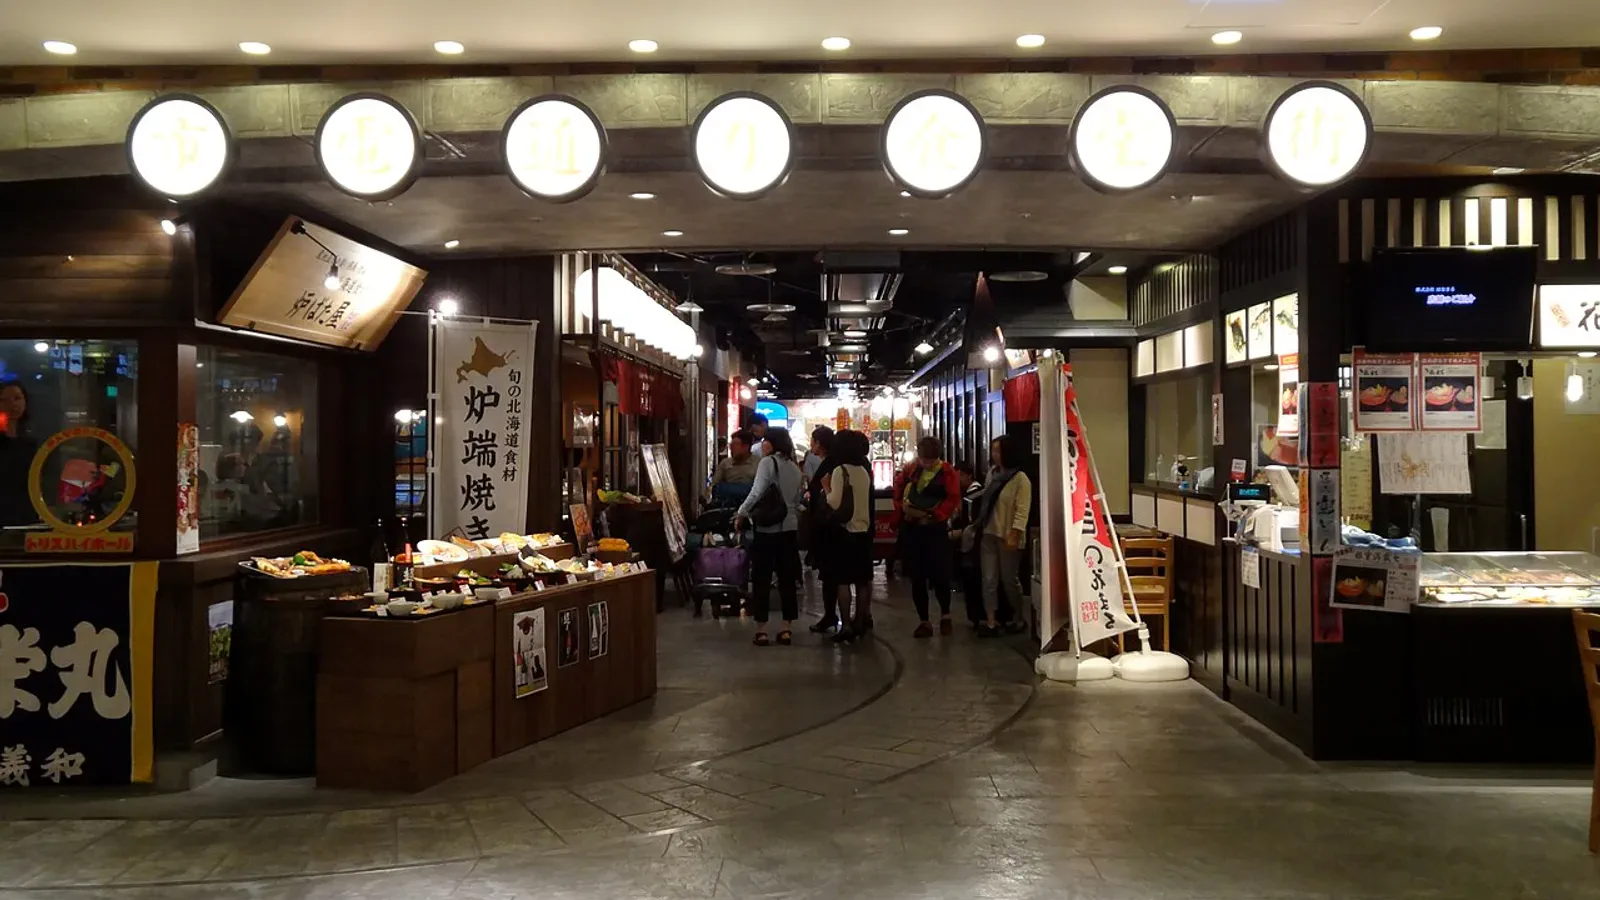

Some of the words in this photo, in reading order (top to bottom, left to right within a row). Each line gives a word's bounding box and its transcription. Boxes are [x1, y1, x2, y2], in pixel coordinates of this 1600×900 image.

[460, 385, 501, 541] 炉端焼き
[502, 369, 522, 482] 旬の北海道食材
